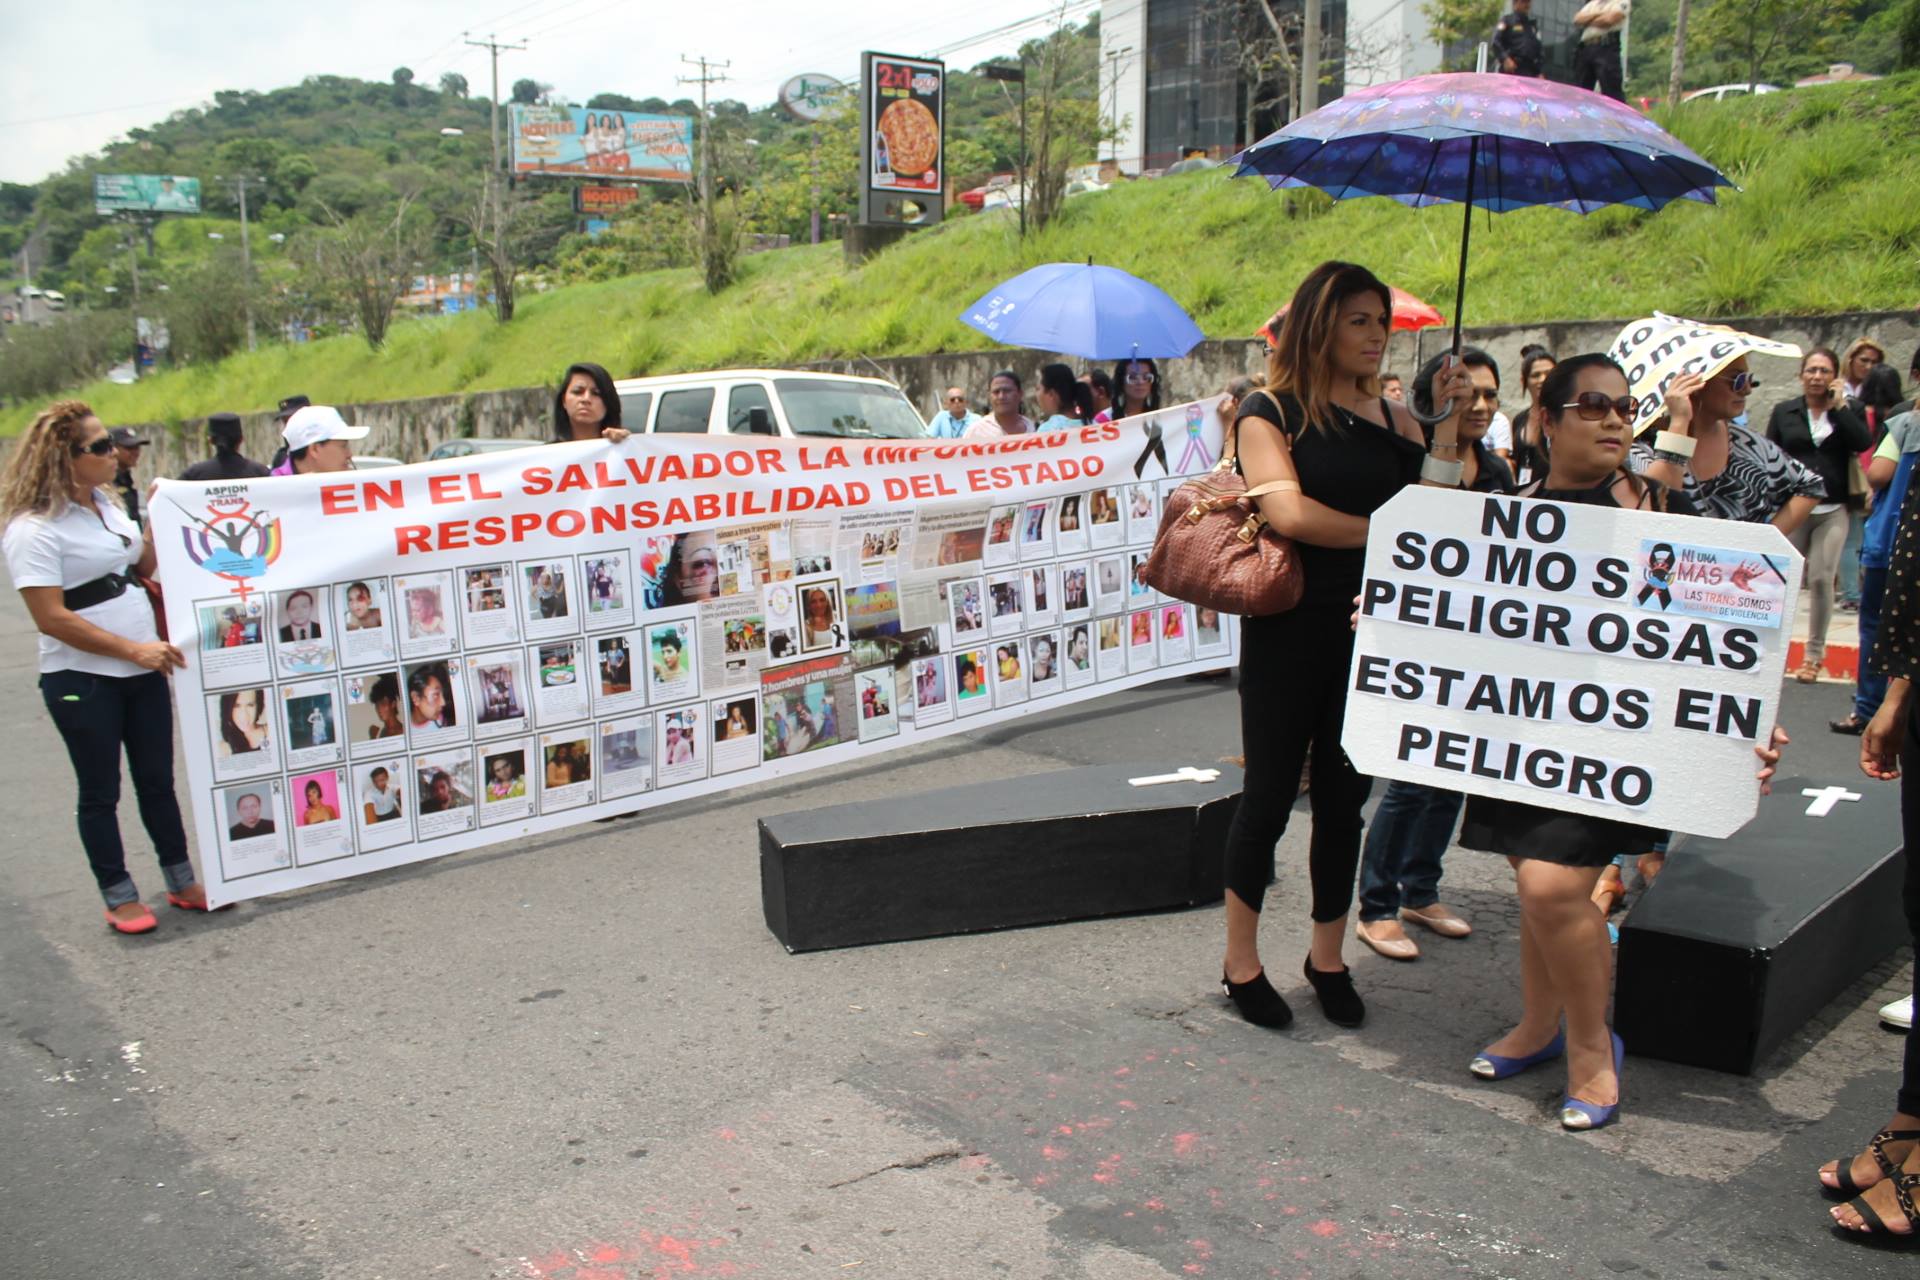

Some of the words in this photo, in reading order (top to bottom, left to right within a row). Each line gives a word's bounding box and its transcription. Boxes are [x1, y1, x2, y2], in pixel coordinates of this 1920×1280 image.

[320, 480, 404, 516] EN
[428, 473, 502, 504] EL
[521, 448, 787, 495] SALVADOR
[800, 445, 850, 472] LA
[864, 433, 1068, 465] IMPUNIDAD
[1080, 421, 1120, 444] ES
[205, 485, 248, 496] ASPIDH
[210, 497, 244, 507] TRANS
[394, 481, 871, 556] RESPONSABILIDAD
[883, 474, 957, 502] DEL
[967, 455, 1104, 492] ESTADO
[1480, 498, 1566, 544] NO
[1681, 549, 1694, 562] NI
[1698, 553, 1717, 563] UNA
[1684, 590, 1702, 601] LAS
[1705, 592, 1736, 606] TRANS
[1737, 597, 1772, 611] SOMOS
[1719, 607, 1729, 616] DE
[1731, 609, 1769, 621] VIOLENCIA
[1673, 688, 1761, 739] EN
[1396, 724, 1653, 806] PELIGRO
